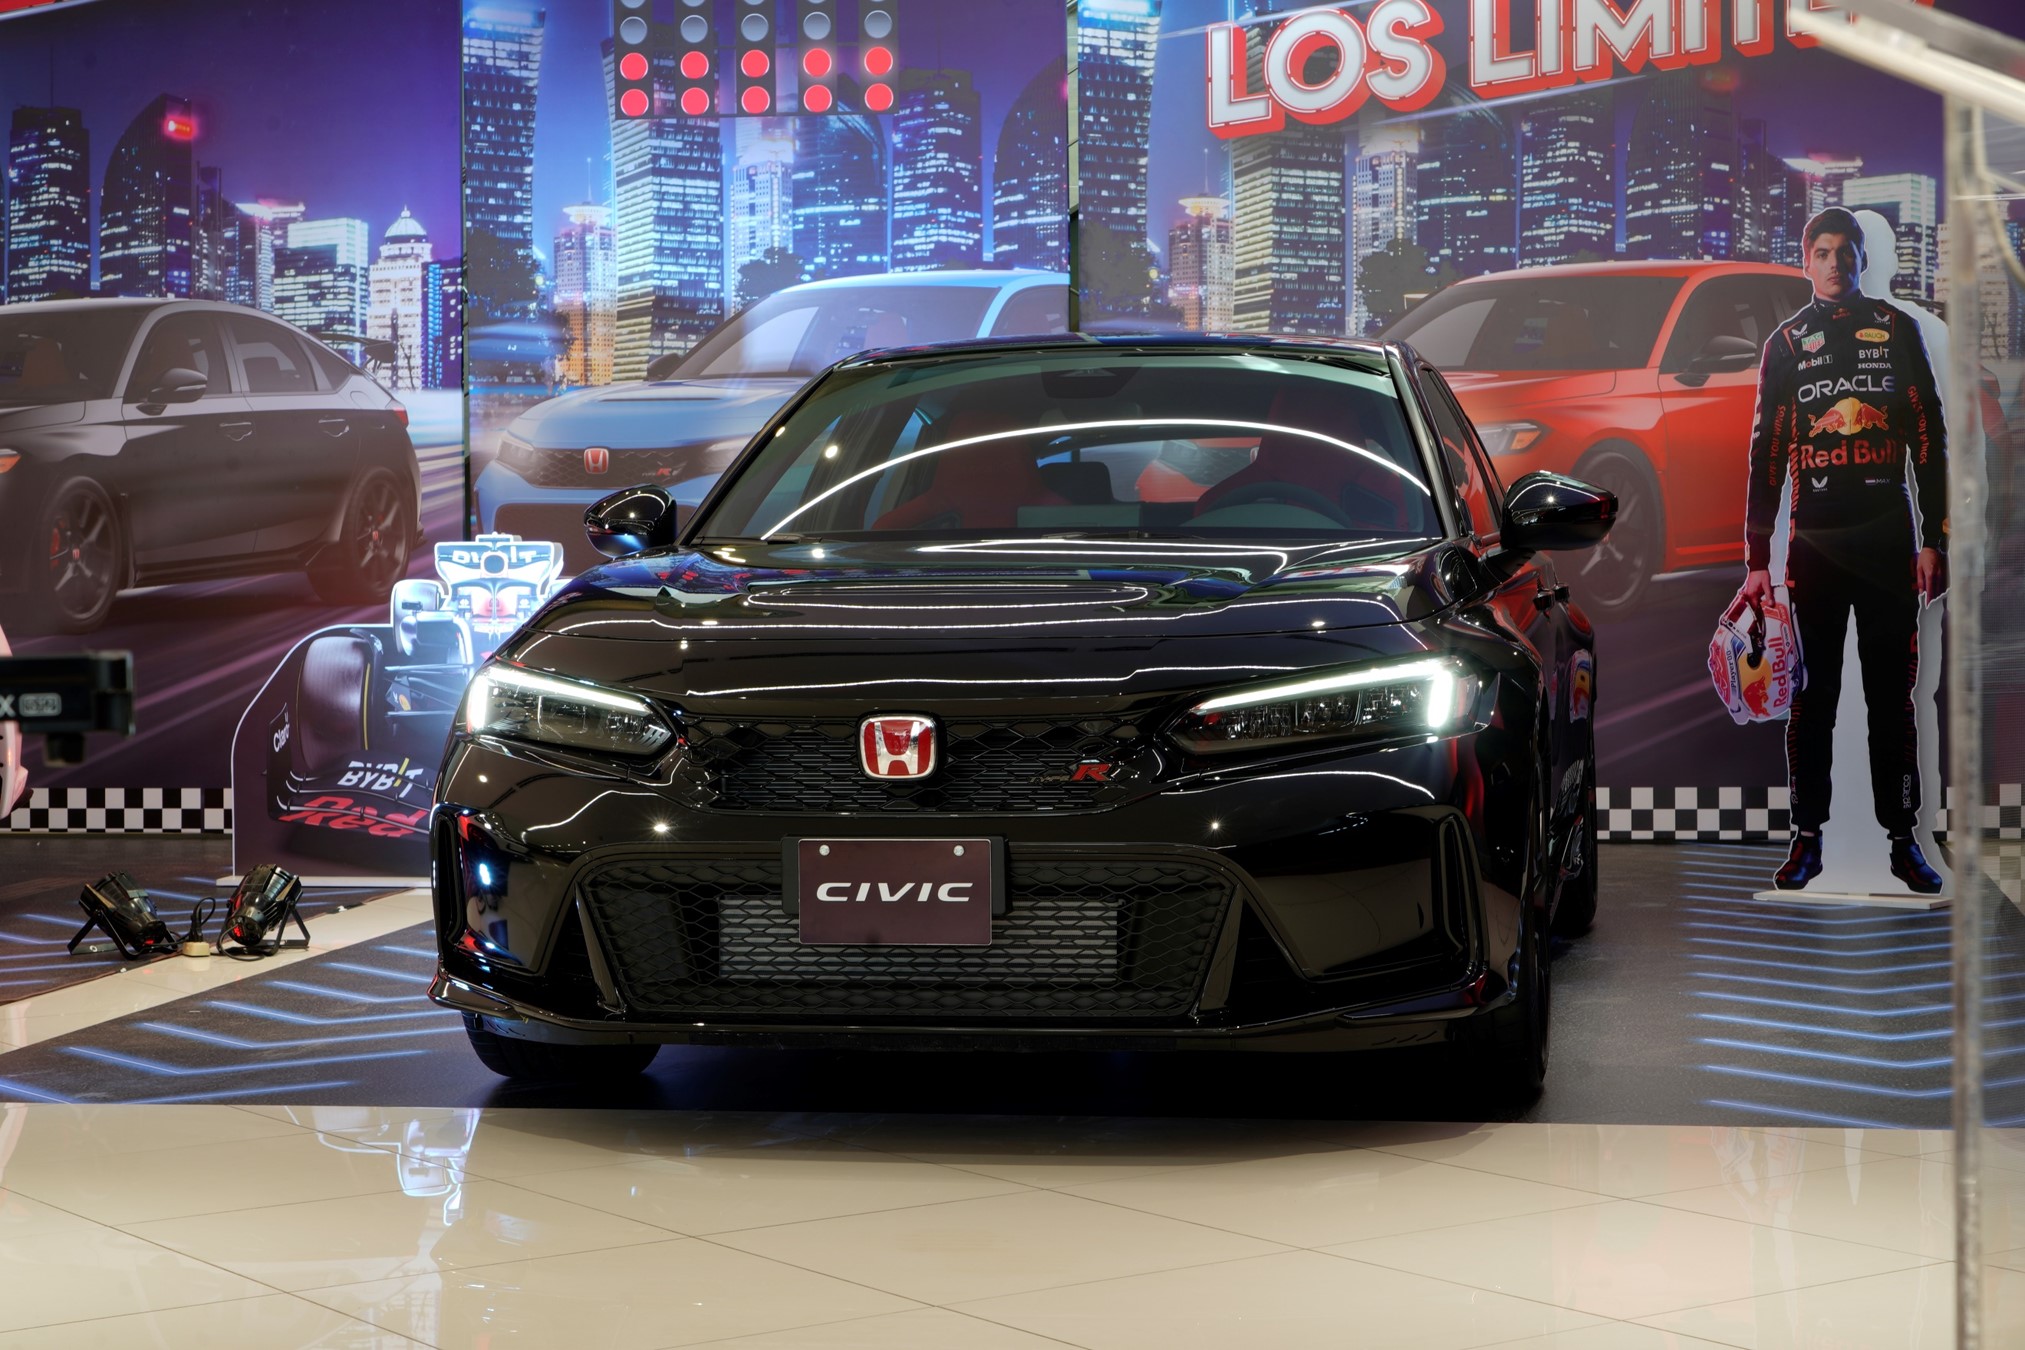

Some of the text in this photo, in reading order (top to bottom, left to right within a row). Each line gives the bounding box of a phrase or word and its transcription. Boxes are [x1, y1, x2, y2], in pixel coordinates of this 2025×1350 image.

[1206, 0, 1446, 138] LOS
[1864, 331, 1886, 340] RAUCH
[1798, 355, 1823, 371] Mobil
[1858, 346, 1890, 359] BYBIT
[1798, 375, 1895, 403] ORACLE
[1770, 437, 1780, 458] YOU
[1775, 404, 1787, 436] WINGS
[1801, 438, 1897, 470] Red Bull
[1768, 637, 1786, 674] Bull
[1729, 661, 1737, 688] Player
[1773, 676, 1788, 708] Red
[273, 724, 290, 752] Claro
[337, 757, 424, 798] BYBIT
[1071, 763, 1112, 782] R
[279, 796, 429, 837] Red
[816, 882, 973, 902] CIVIC
